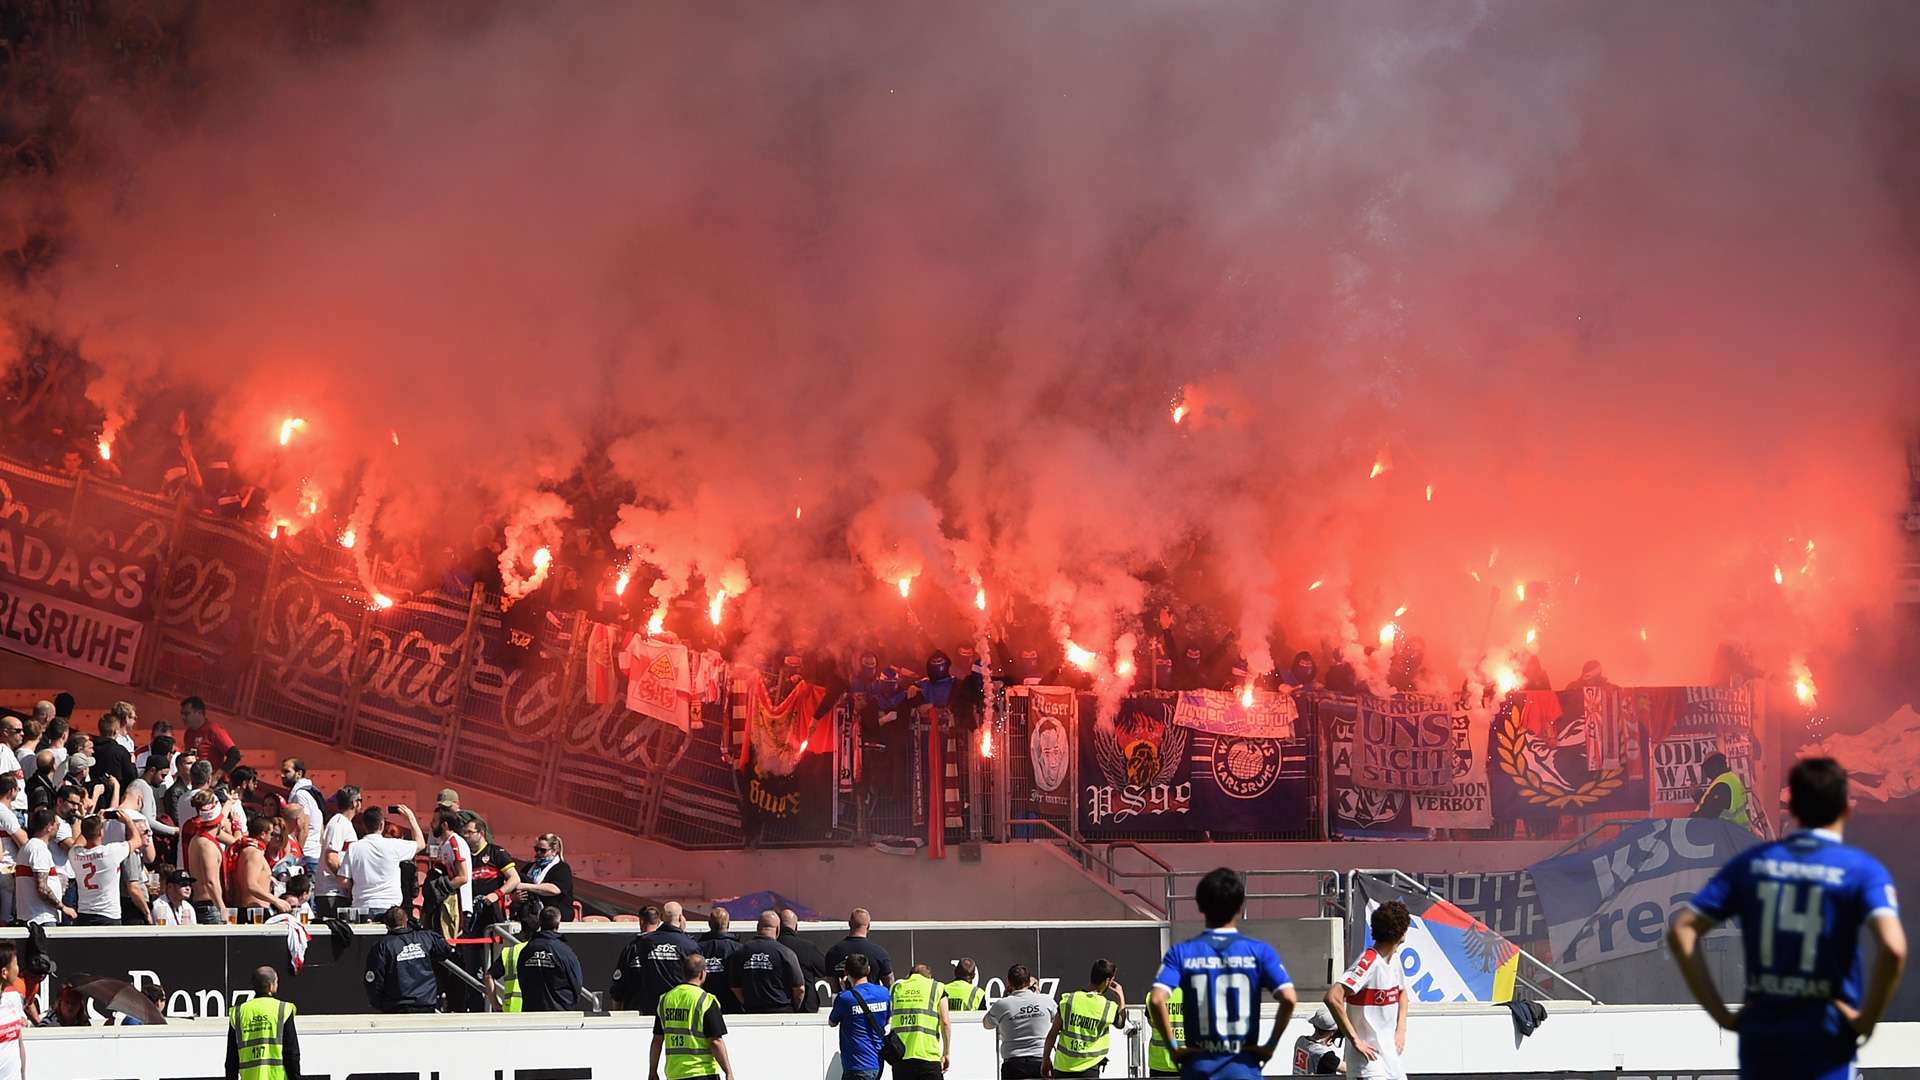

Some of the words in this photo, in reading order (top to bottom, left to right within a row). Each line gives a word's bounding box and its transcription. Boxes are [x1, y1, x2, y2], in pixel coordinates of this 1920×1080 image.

[1362, 709, 1450, 748] UNS
[1364, 744, 1449, 770] NICHT
[1217, 761, 1277, 793] KARLSRUHE
[1363, 765, 1448, 787] STILL
[1415, 796, 1486, 811] VERBOT
[1592, 818, 1715, 904] KSC
[82, 862, 99, 890] 2
[1758, 880, 1824, 972] 14
[1020, 1005, 1040, 1015] SDS
[1191, 973, 1250, 1036] 10
[900, 1014, 916, 1025] 0120
